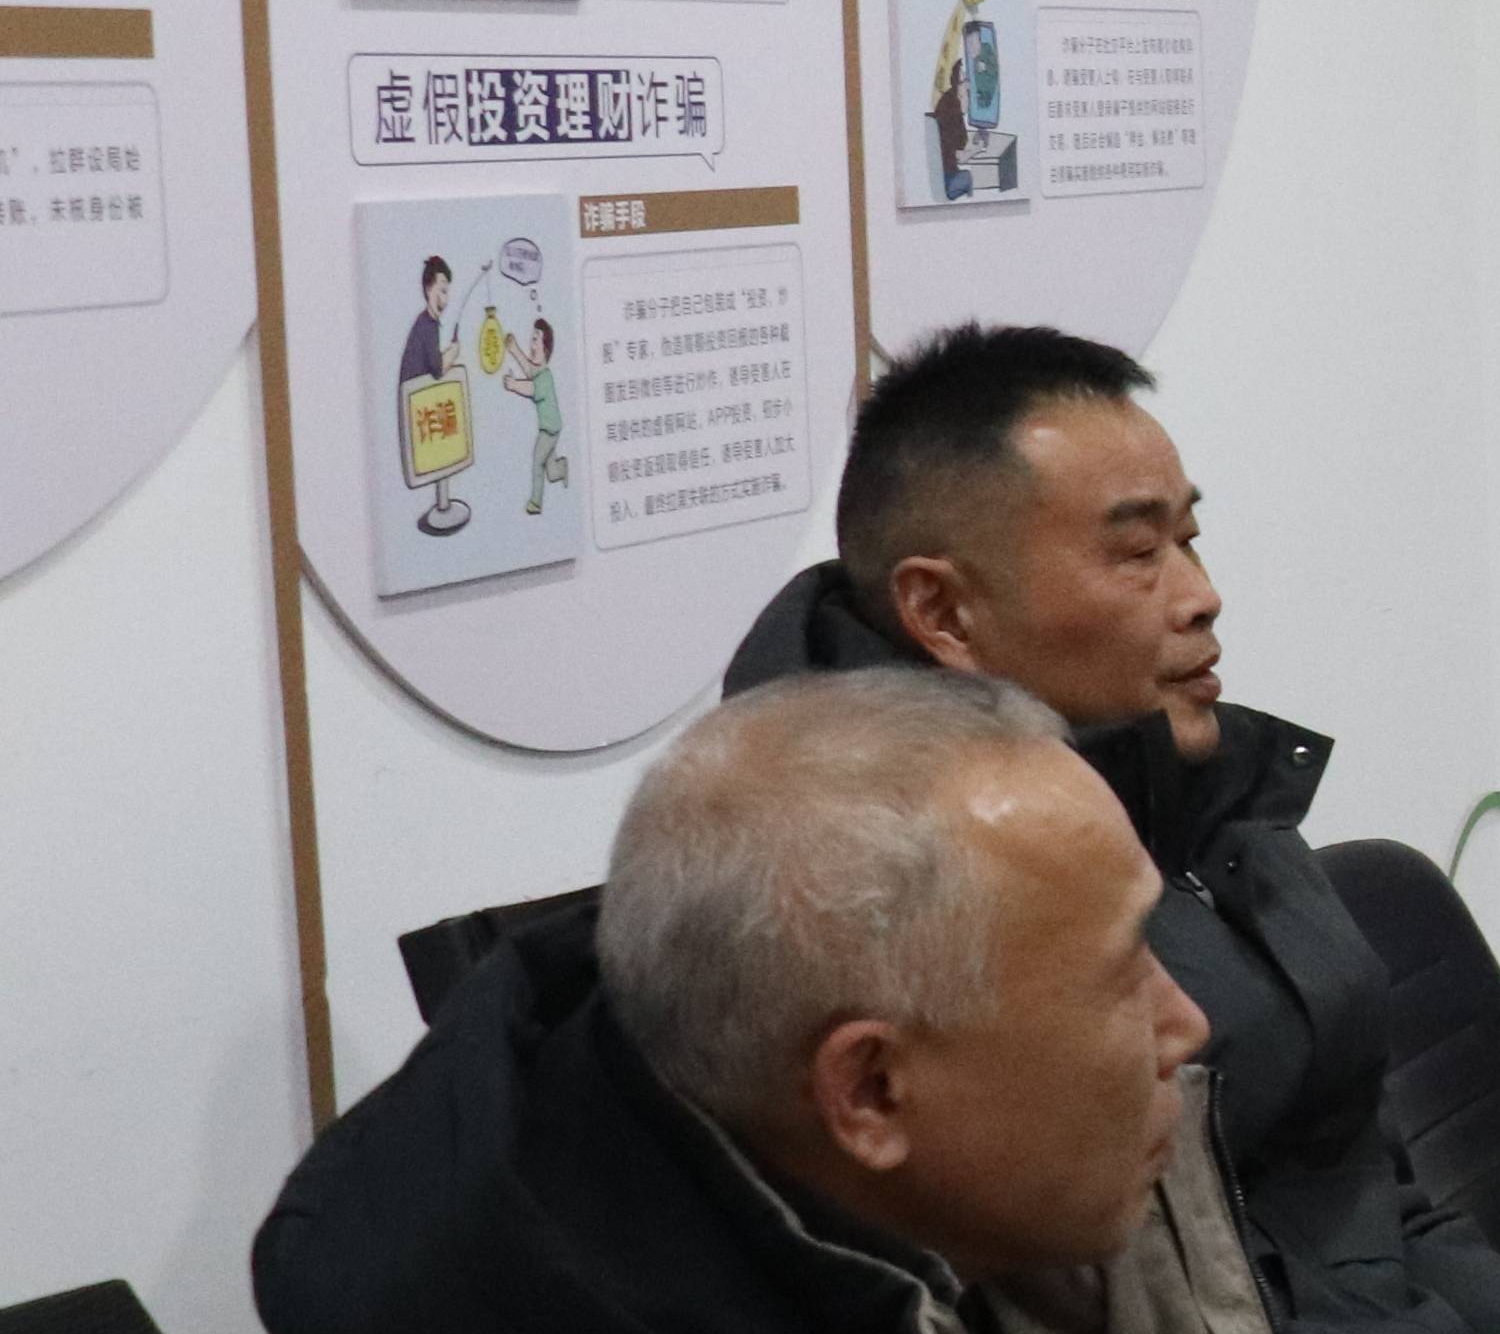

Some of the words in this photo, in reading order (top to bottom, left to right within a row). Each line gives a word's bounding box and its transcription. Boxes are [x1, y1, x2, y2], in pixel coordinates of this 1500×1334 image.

[374, 68, 708, 146] 虚假投资理财诈骗
[583, 201, 646, 232] 诈骗手段
